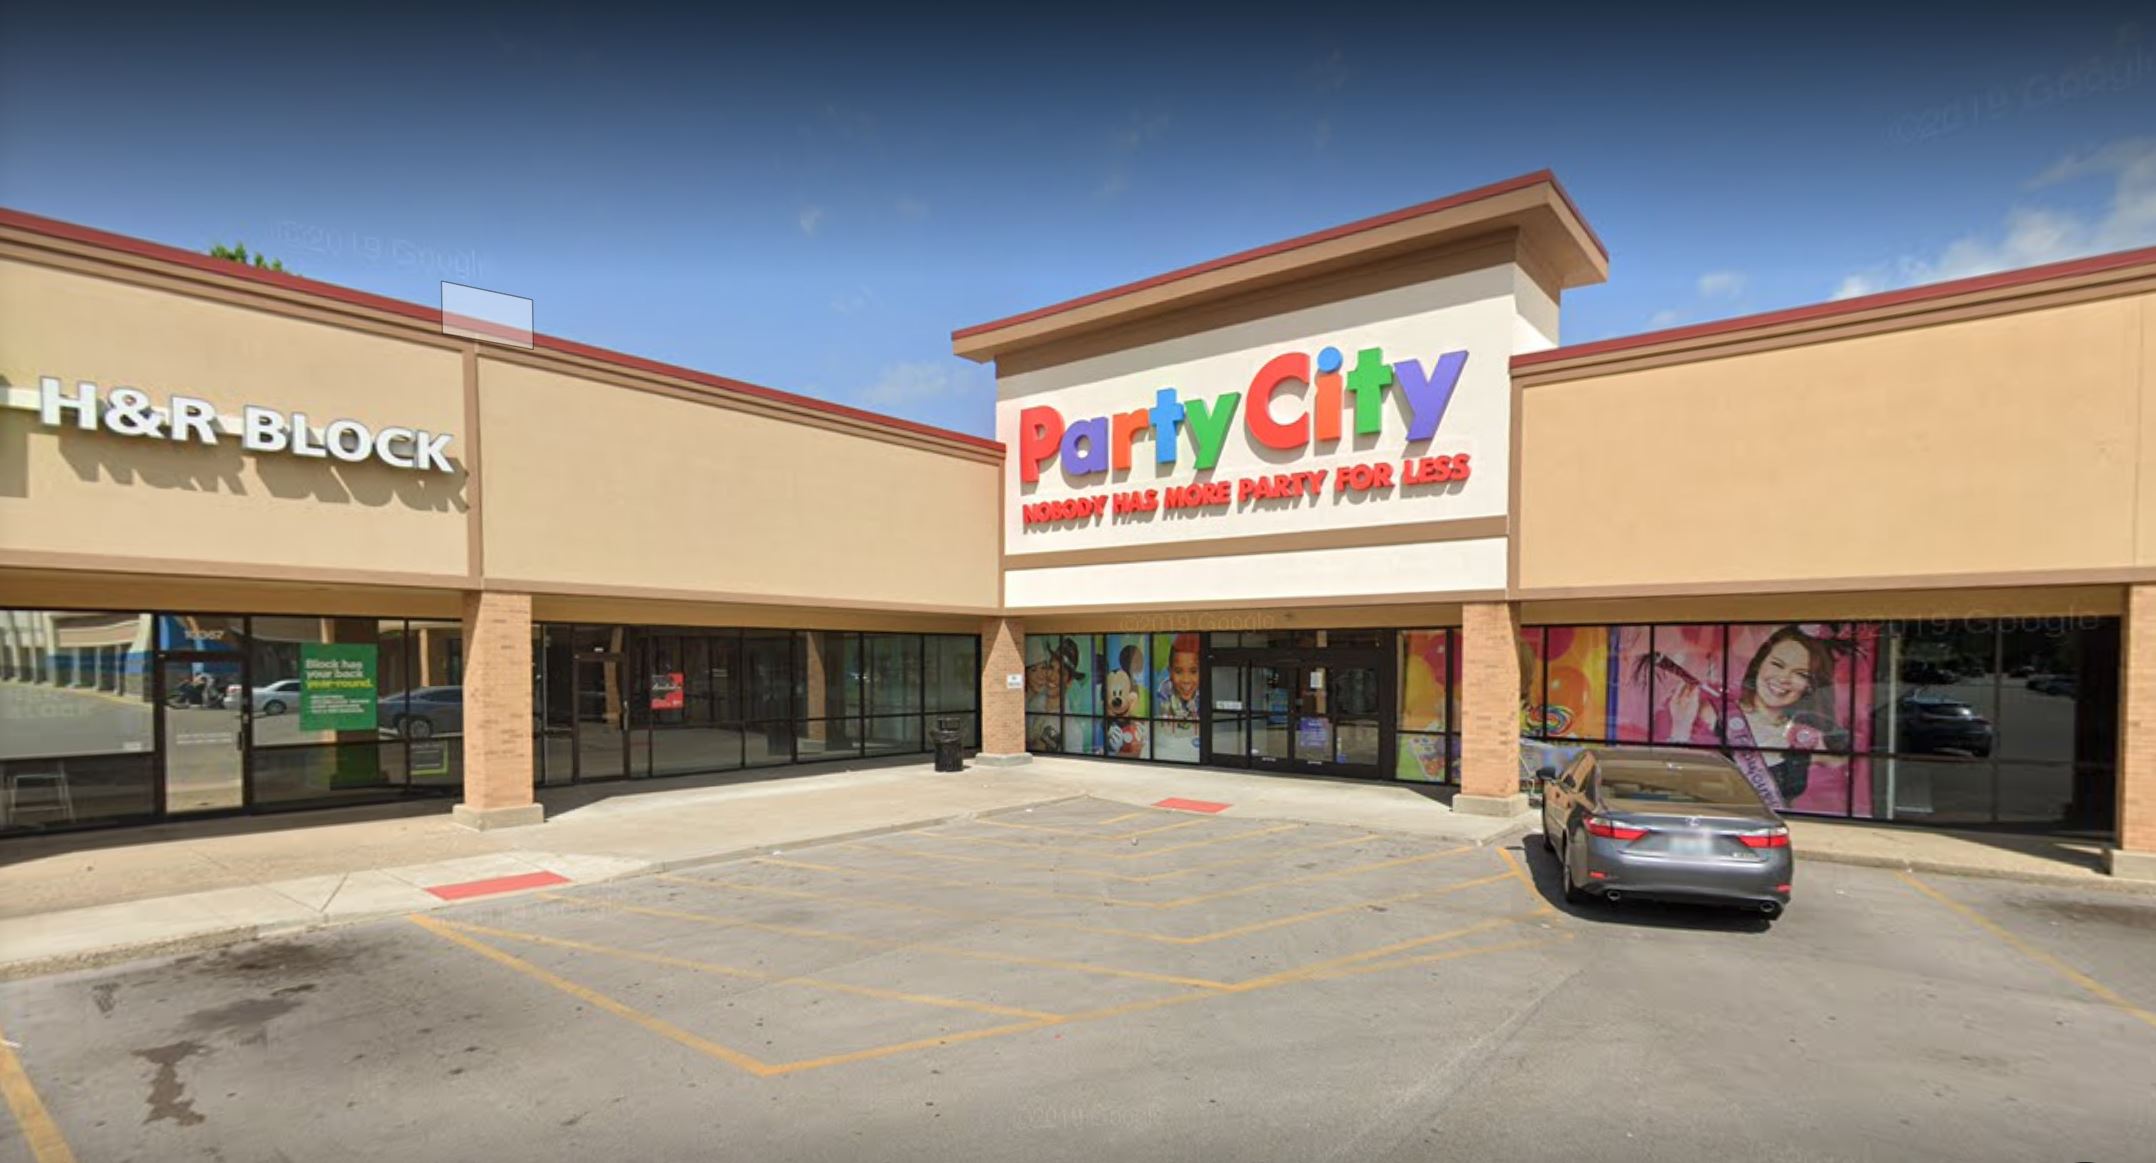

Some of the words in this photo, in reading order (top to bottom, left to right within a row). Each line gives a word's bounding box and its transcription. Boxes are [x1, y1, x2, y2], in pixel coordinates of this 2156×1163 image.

[39, 376, 218, 445] H&R
[243, 404, 455, 473] BLOCK
[1020, 387, 1242, 486] Party
[1245, 346, 1469, 451] City
[1022, 495, 1108, 526] NOBODY
[1113, 489, 1158, 515] HAS
[1164, 481, 1232, 511] MORE
[1238, 469, 1328, 503] PARTY
[1335, 462, 1395, 494] FOR
[1403, 453, 1471, 487] LESS
[305, 658, 339, 669] Block
[341, 659, 364, 669] has
[306, 671, 334, 680] your
[335, 669, 364, 678] back
